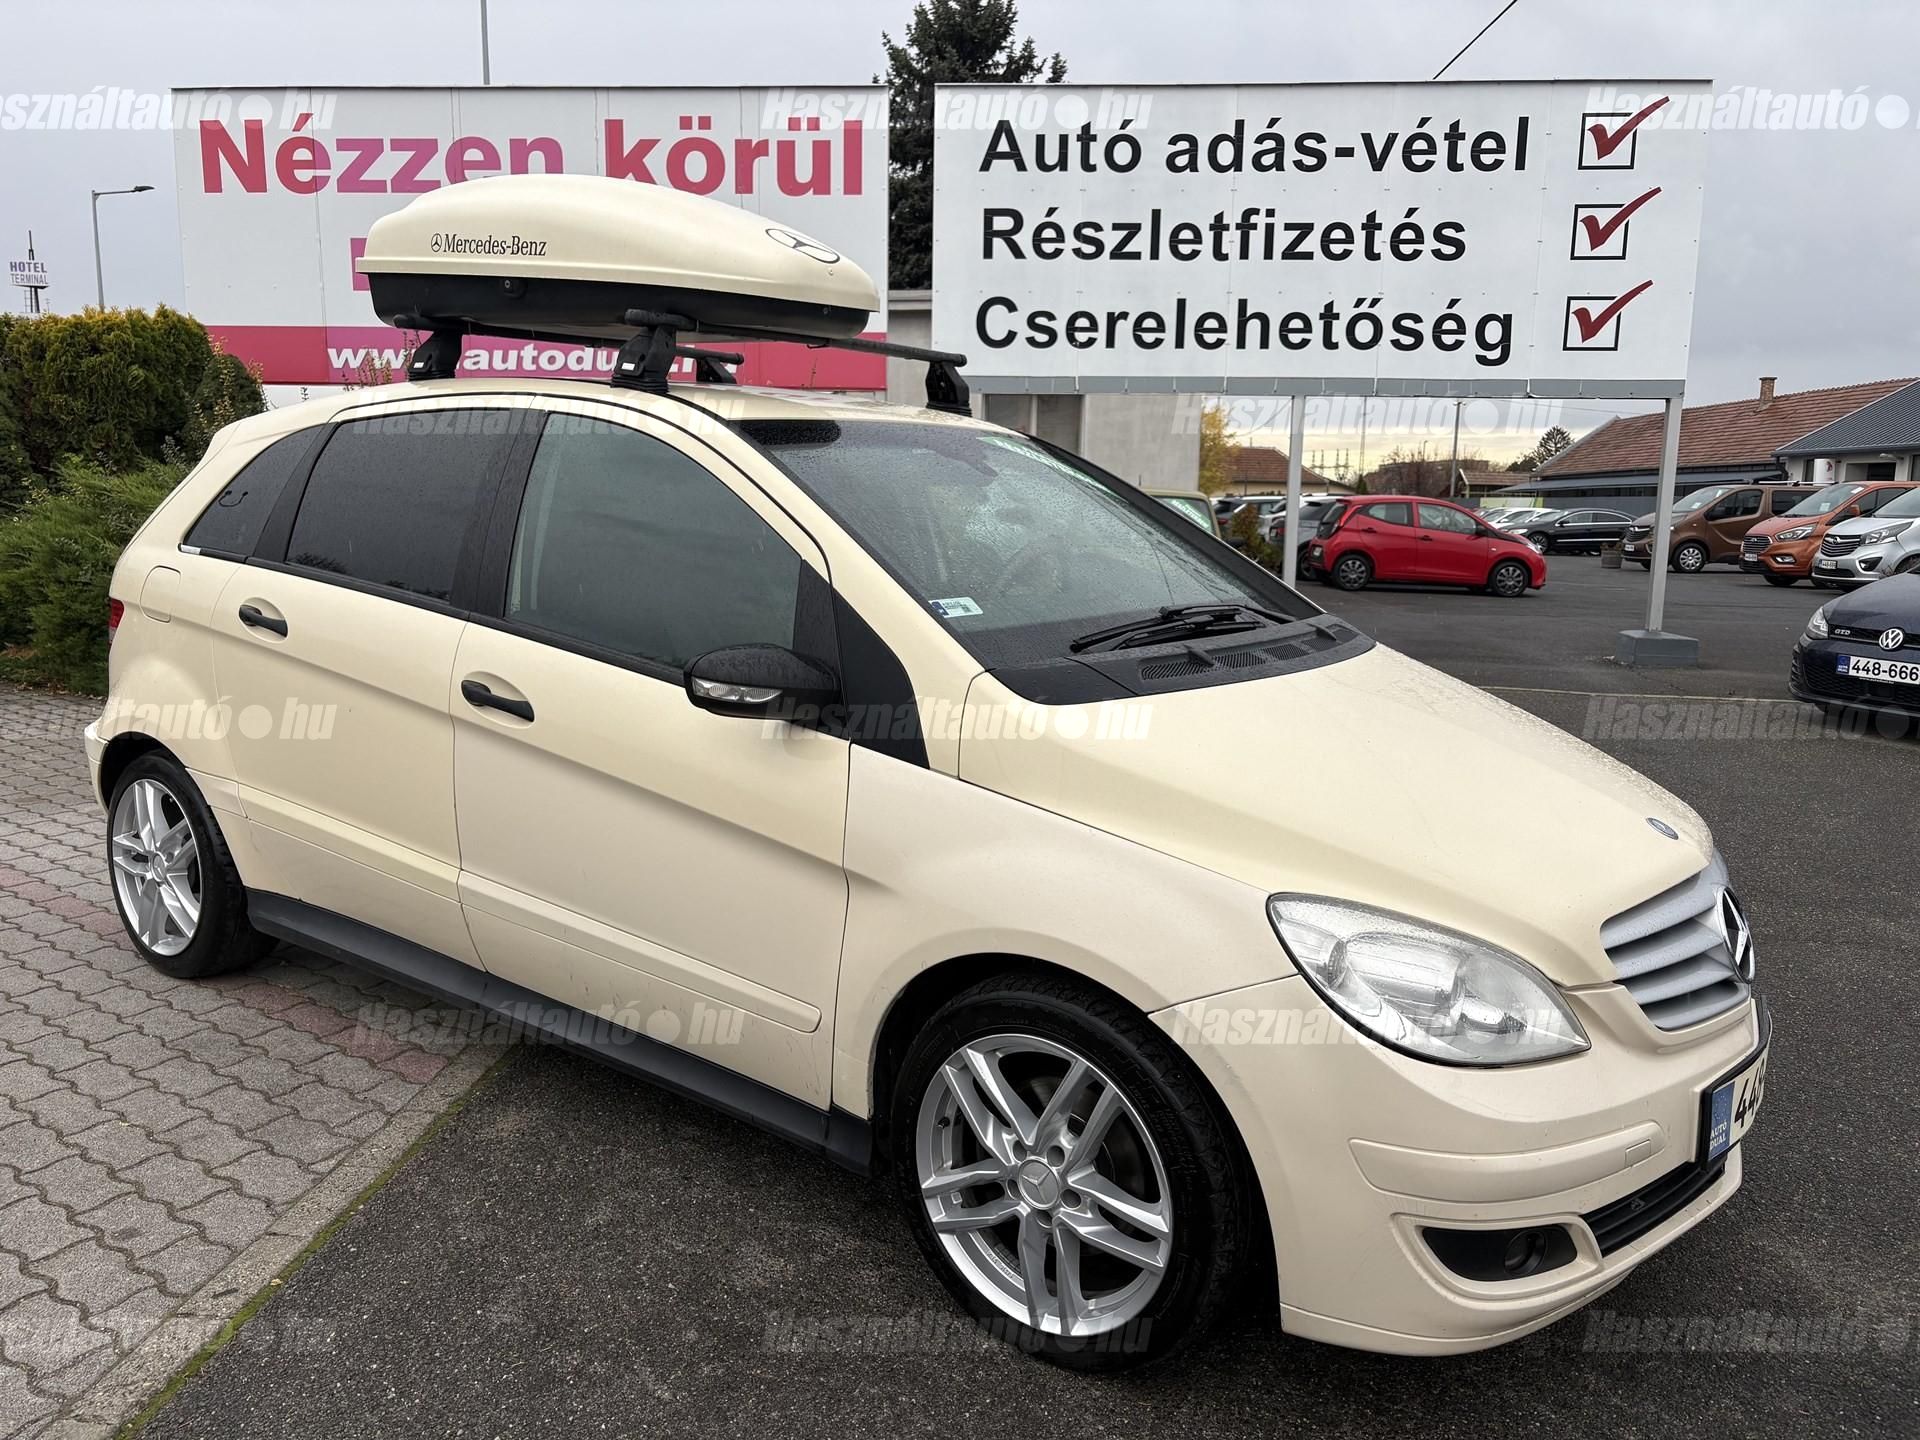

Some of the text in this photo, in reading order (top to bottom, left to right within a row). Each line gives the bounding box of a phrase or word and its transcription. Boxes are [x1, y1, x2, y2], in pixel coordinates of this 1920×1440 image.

[200, 112, 863, 196] Nézzen körül
[978, 115, 1529, 174] Autó adás-vétel
[443, 233, 547, 256] Mercedes-Benz
[981, 206, 1467, 262] Részletfizetés
[9, 261, 47, 273] HOTEL
[10, 273, 48, 285] TERMINAL
[976, 296, 1514, 367] Cserelehetőség
[1851, 658, 1920, 682] 448-666
